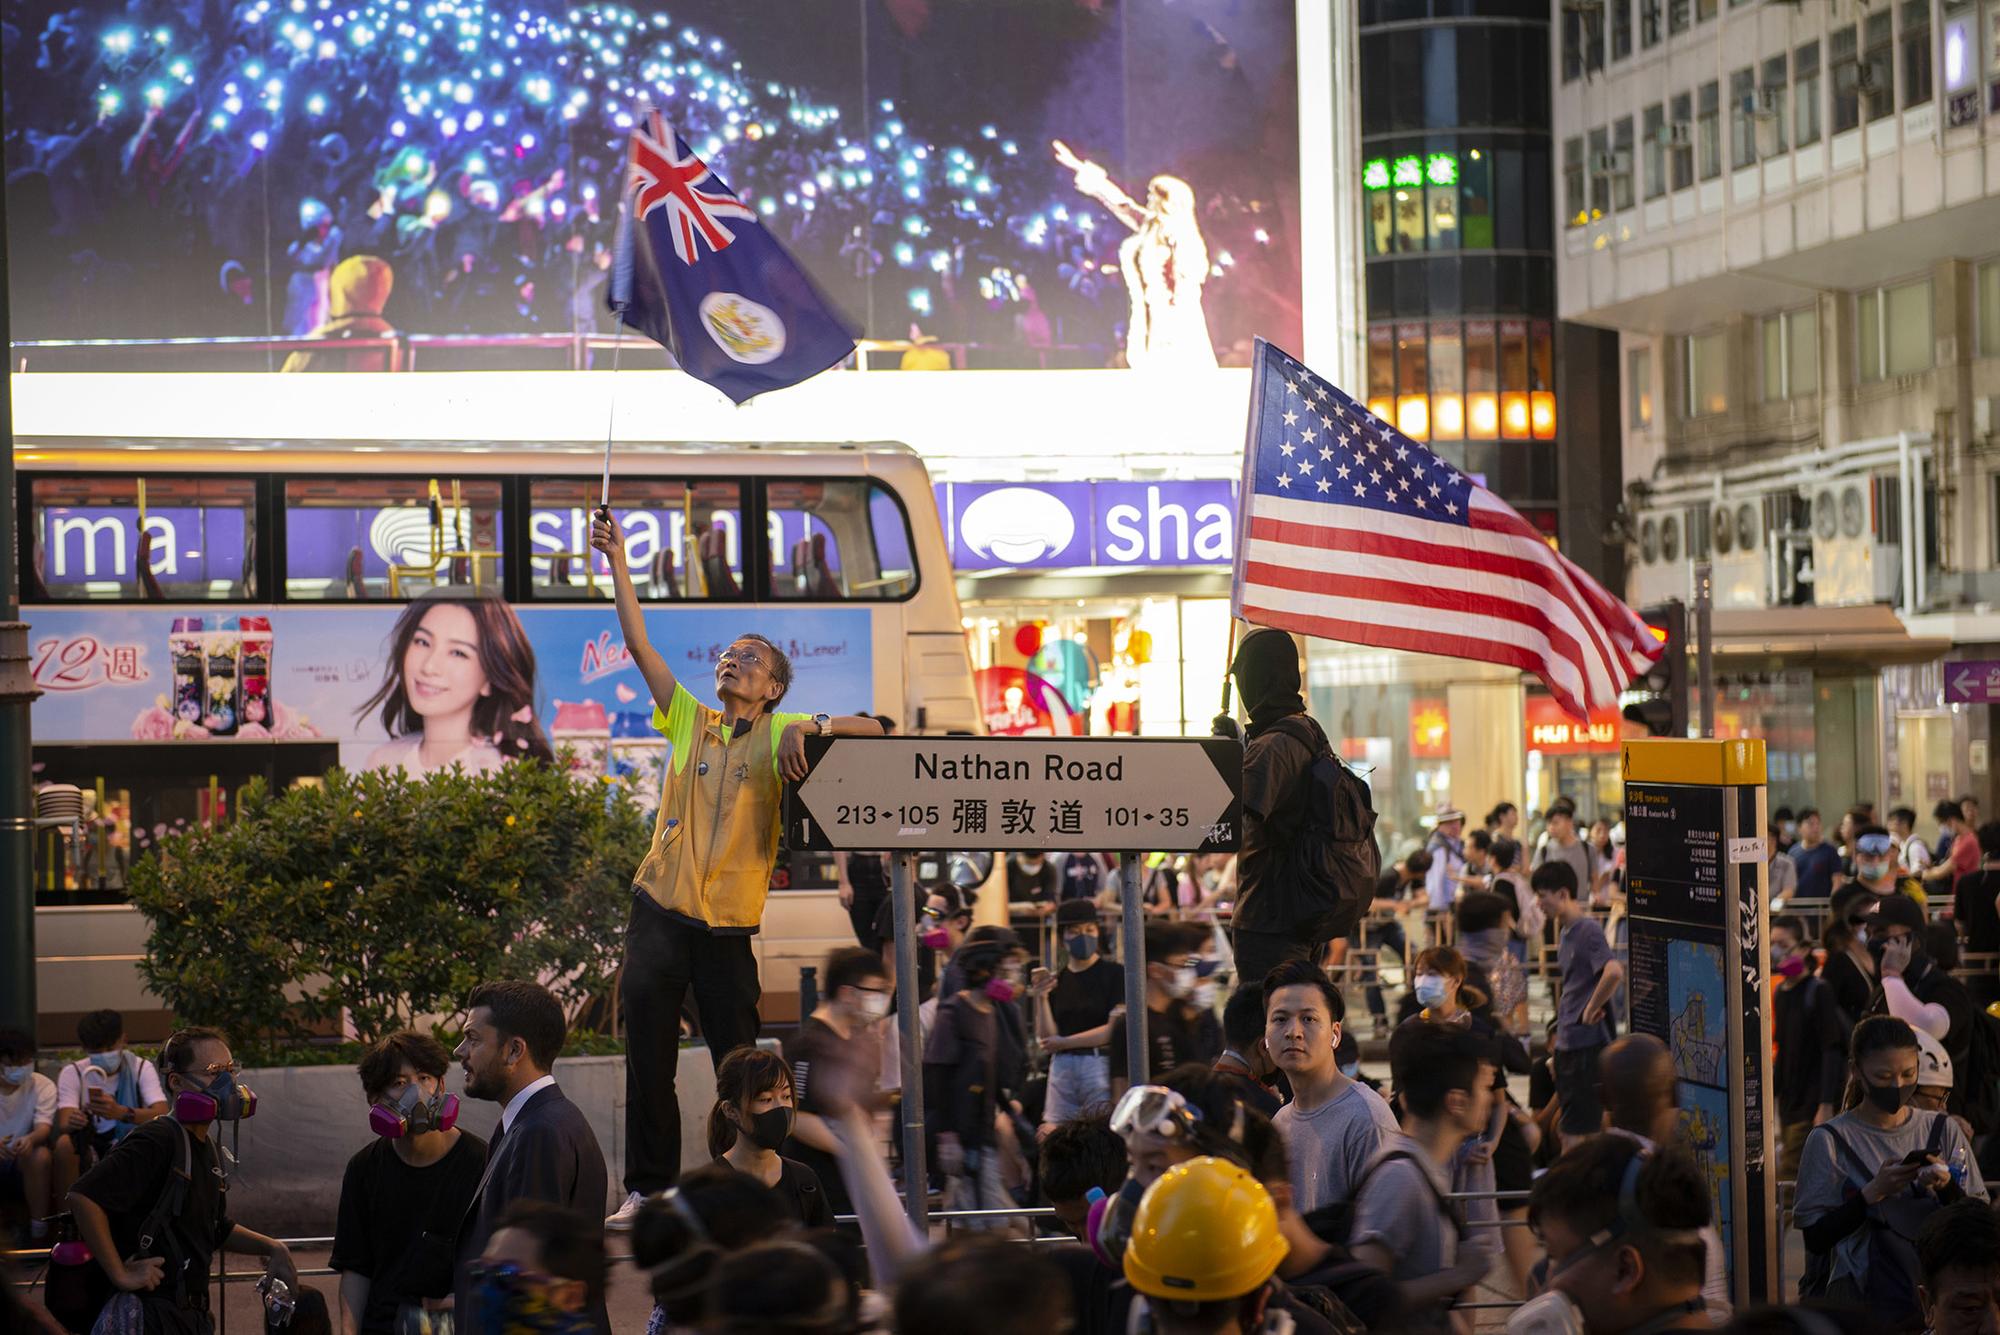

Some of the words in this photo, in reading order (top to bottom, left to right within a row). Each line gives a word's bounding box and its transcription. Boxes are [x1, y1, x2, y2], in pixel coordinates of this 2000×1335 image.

[1533, 724, 1569, 744] HUI
[915, 752, 1030, 780] Nathan
[1045, 754, 1123, 781] Road
[836, 805, 877, 825] 213
[898, 806, 940, 825] 105
[952, 799, 1085, 835] 彌敦道
[1104, 807, 1140, 826] 101
[1159, 808, 1190, 827] 35
